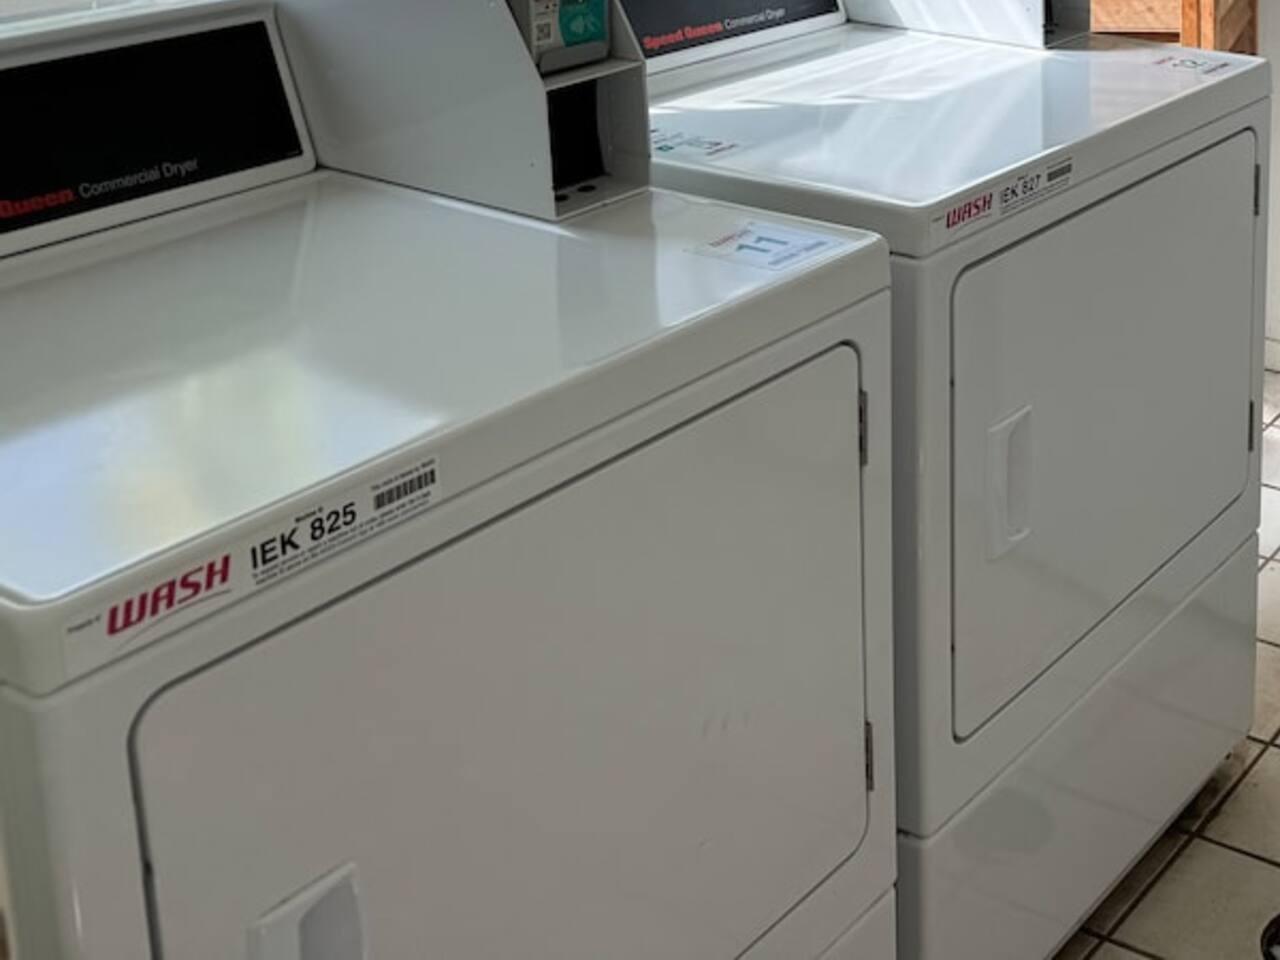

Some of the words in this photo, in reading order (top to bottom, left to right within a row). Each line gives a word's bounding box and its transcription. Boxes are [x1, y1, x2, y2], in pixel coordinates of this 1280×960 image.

[78, 166, 162, 198] Commercial
[161, 157, 199, 178] Dryer
[946, 192, 993, 229] WASH
[106, 553, 232, 636] WASH
[250, 526, 300, 570] IEK
[309, 501, 357, 542] 825
